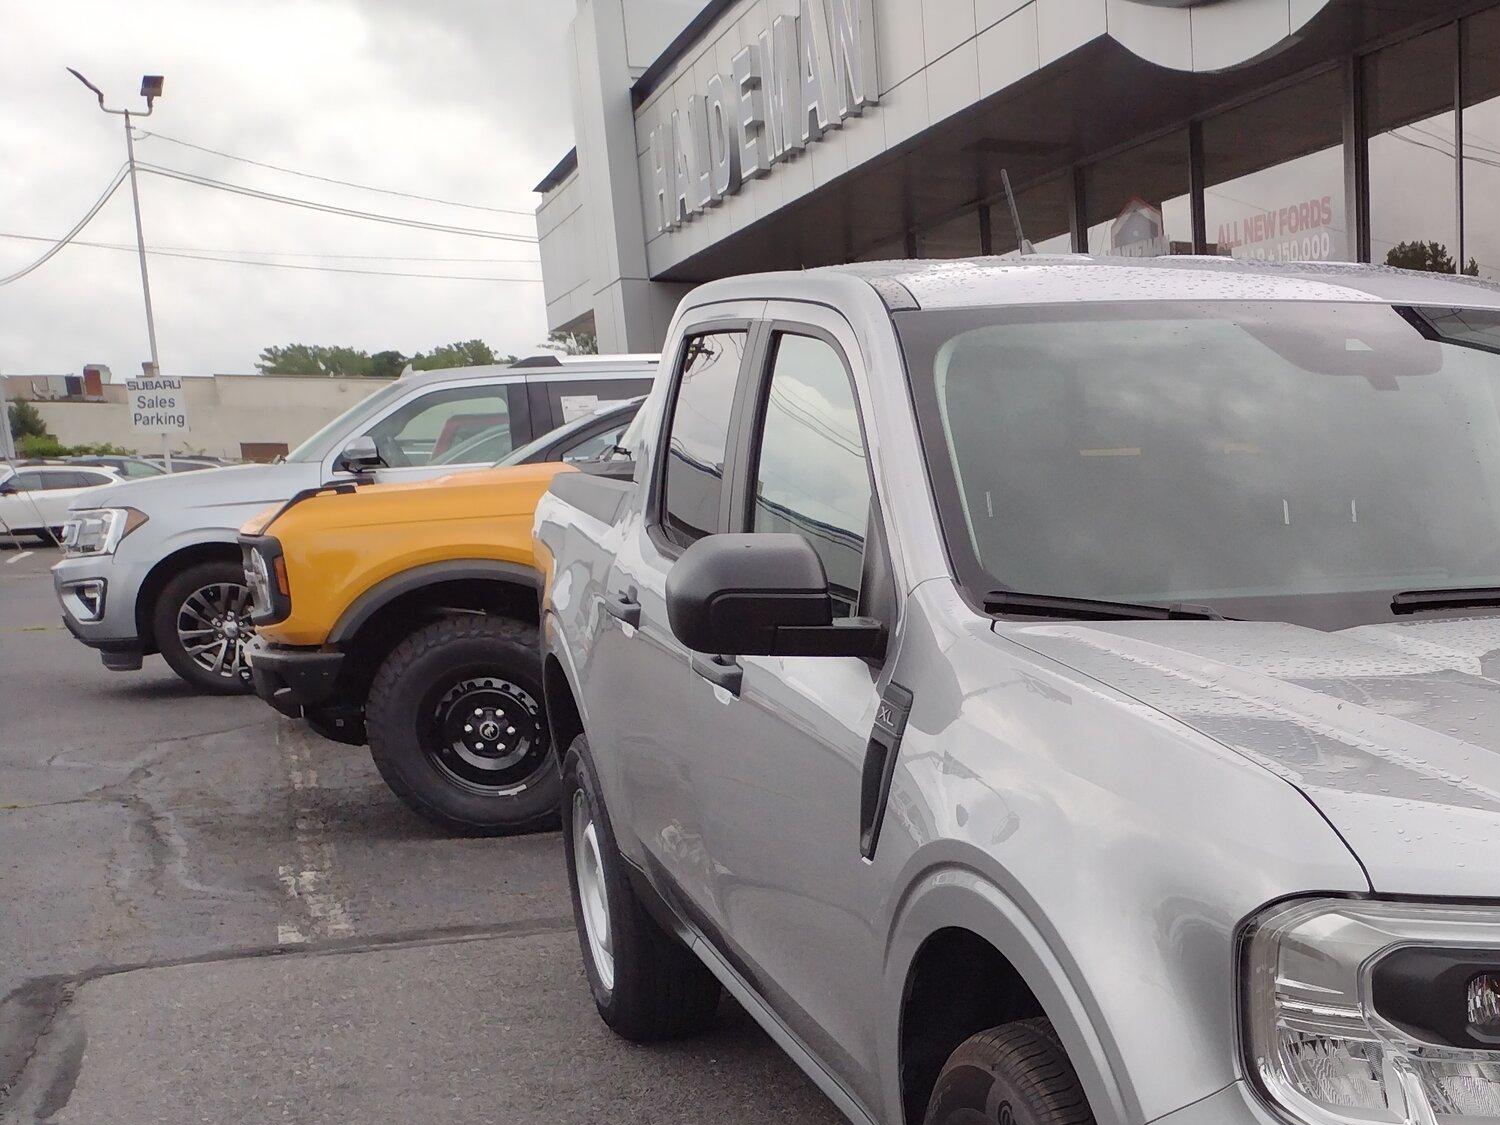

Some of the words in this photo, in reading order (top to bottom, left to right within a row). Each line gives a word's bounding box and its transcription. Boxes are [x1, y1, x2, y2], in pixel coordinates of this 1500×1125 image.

[650, 0, 880, 233] HALDEMAN
[1217, 221, 1242, 254] ALL
[1243, 211, 1277, 244] NEW
[1279, 196, 1332, 236] FORDS
[127, 380, 181, 391] SUBARU
[137, 395, 176, 409] Sales
[133, 412, 185, 427] Parking
[878, 705, 894, 727] XL
